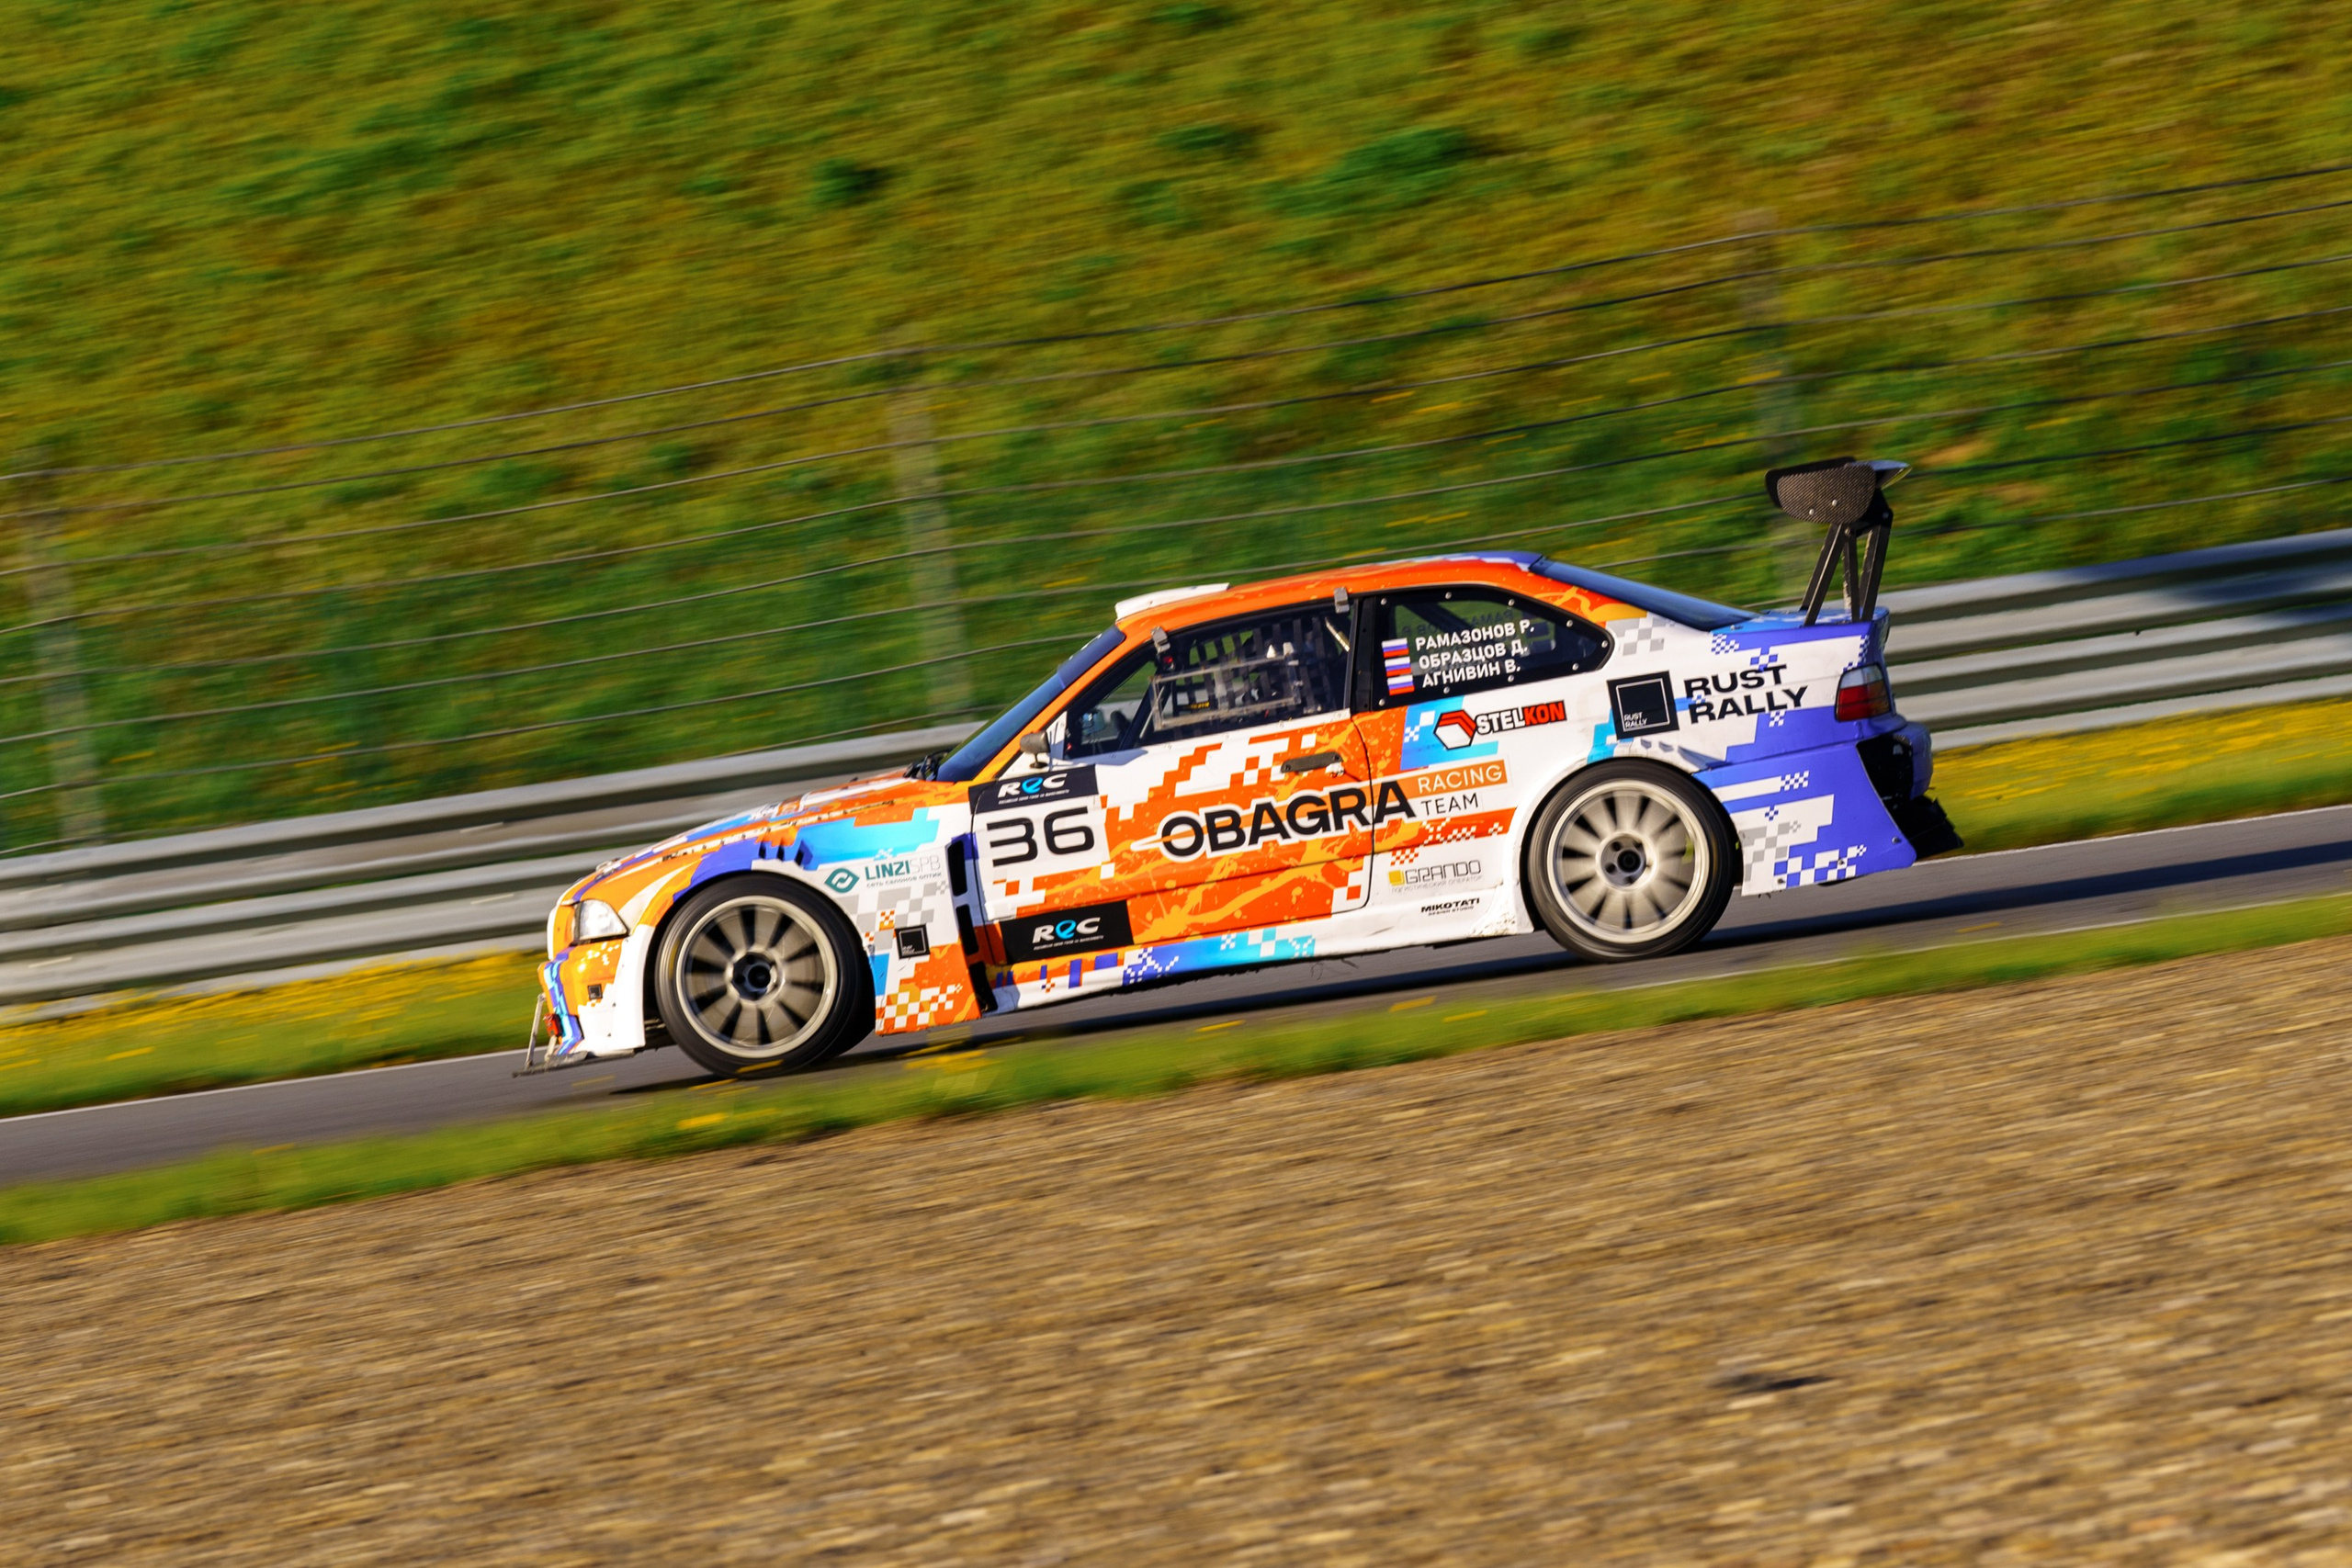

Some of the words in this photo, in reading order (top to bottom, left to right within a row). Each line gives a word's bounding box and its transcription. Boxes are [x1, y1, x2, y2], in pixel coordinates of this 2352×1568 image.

[1416, 622, 1515, 651] РАМАЗОНОВ
[1520, 619, 1534, 634] Р.
[1419, 642, 1507, 670] ОБРАЗЦОВ
[1510, 638, 1528, 657] Д.
[1422, 660, 1500, 688] АГНИВИН
[1505, 659, 1521, 673] В.
[1683, 663, 1787, 698] RUST
[1476, 700, 1566, 735] STELKON
[1688, 685, 1808, 724] RALLY
[1418, 765, 1503, 795] RACING
[1161, 781, 1416, 856] OBAGRA
[1420, 792, 1478, 816] TEAM
[987, 807, 1094, 867] 36
[1405, 860, 1481, 885] GRANDO
[1420, 897, 1480, 913] MIKOTATI
